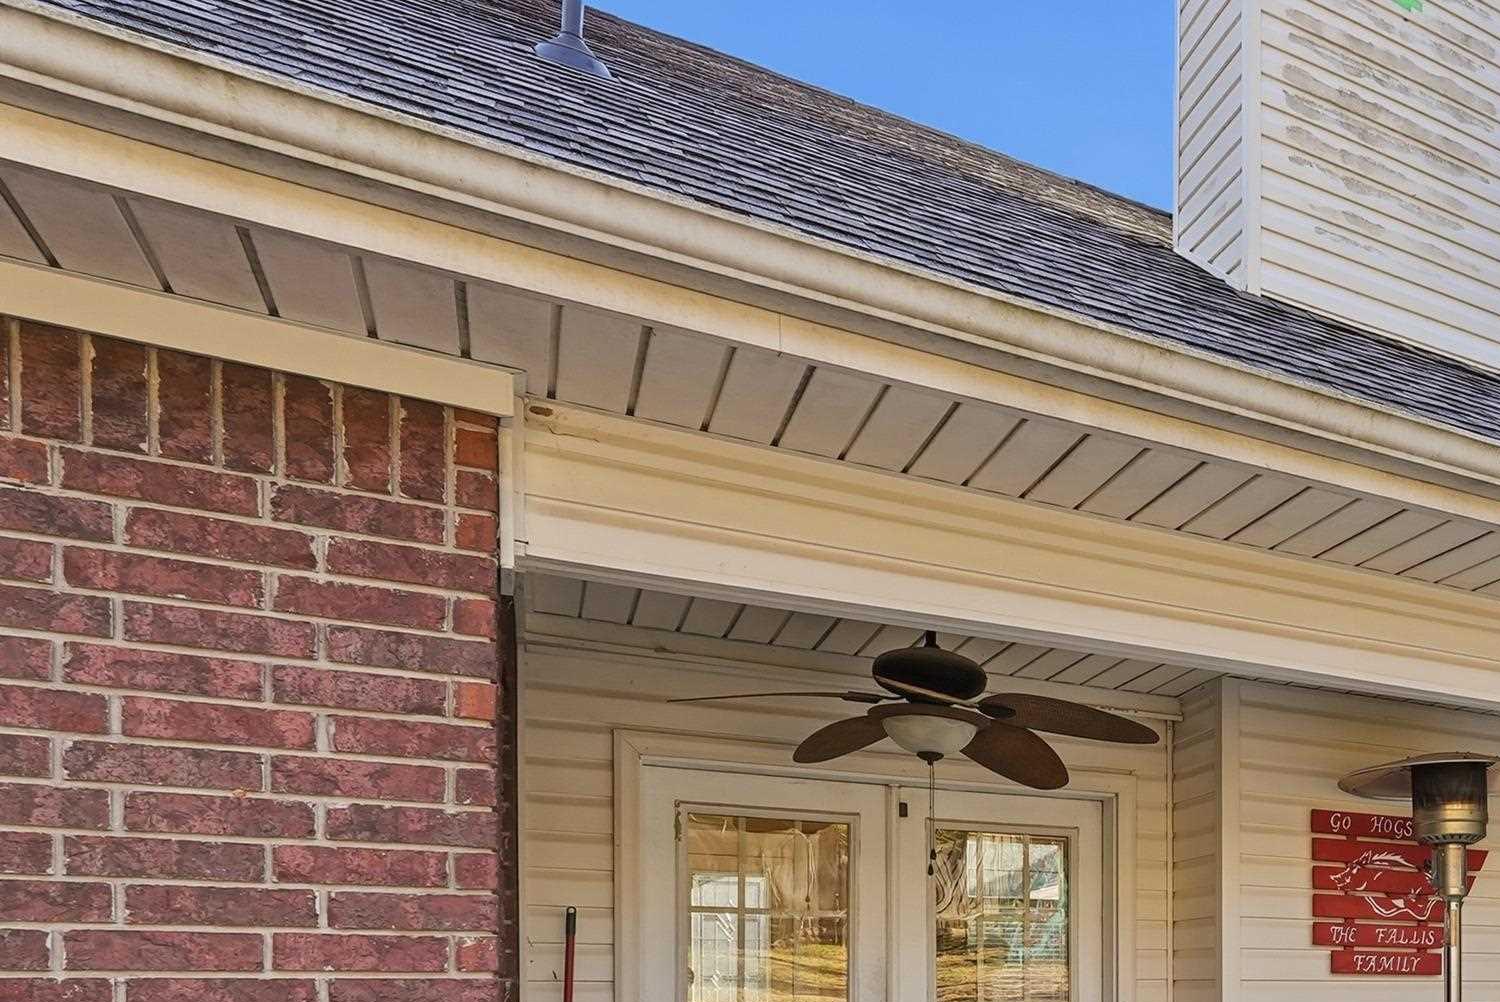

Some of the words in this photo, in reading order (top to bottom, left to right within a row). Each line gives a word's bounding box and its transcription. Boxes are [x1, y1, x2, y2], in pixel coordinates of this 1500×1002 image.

[1330, 813, 1351, 833] GO
[1370, 816, 1413, 839] HOGS
[1330, 926, 1357, 943] THE
[1375, 927, 1435, 945] FALLIS
[1353, 954, 1421, 973] FAMILY
